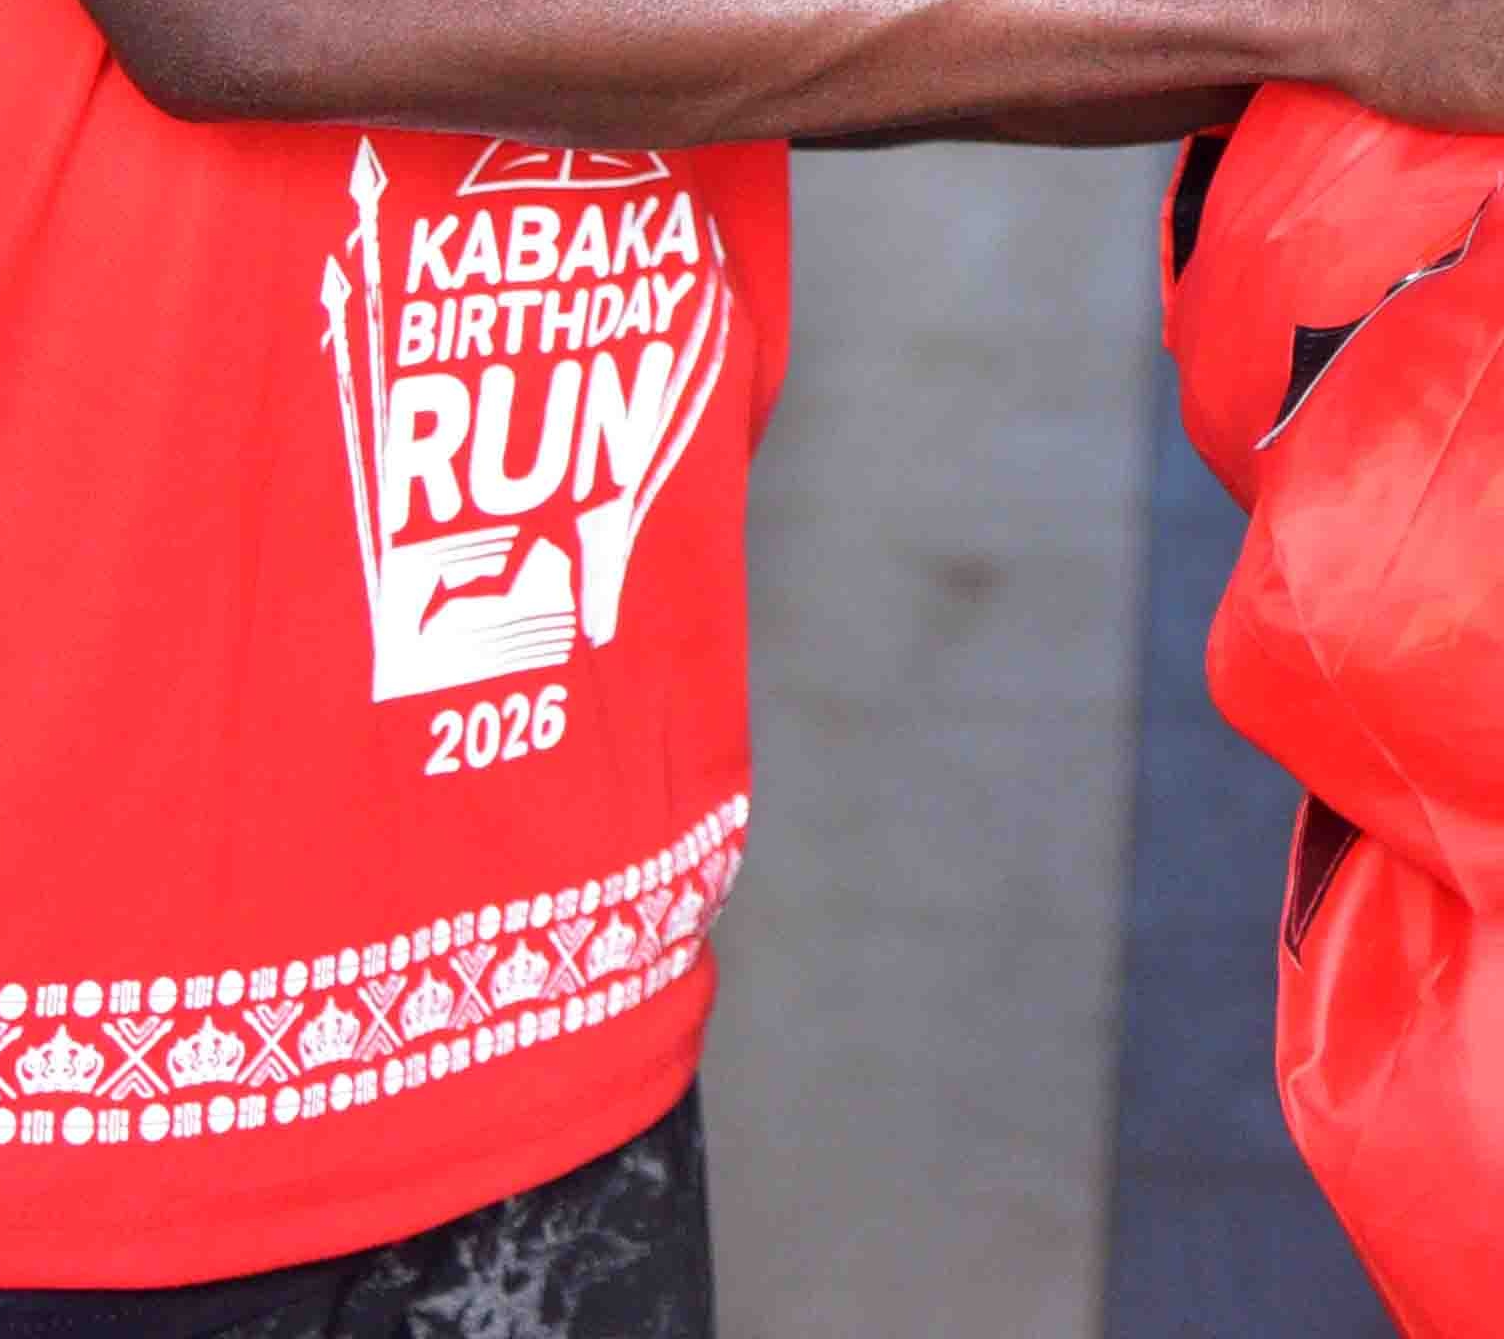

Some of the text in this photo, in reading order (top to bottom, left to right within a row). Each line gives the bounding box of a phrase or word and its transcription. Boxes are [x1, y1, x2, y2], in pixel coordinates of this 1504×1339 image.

[404, 191, 701, 294] KABAKA
[397, 271, 697, 369] BIRTHDAY
[388, 340, 674, 535] RUN
[424, 684, 568, 776] 2026
